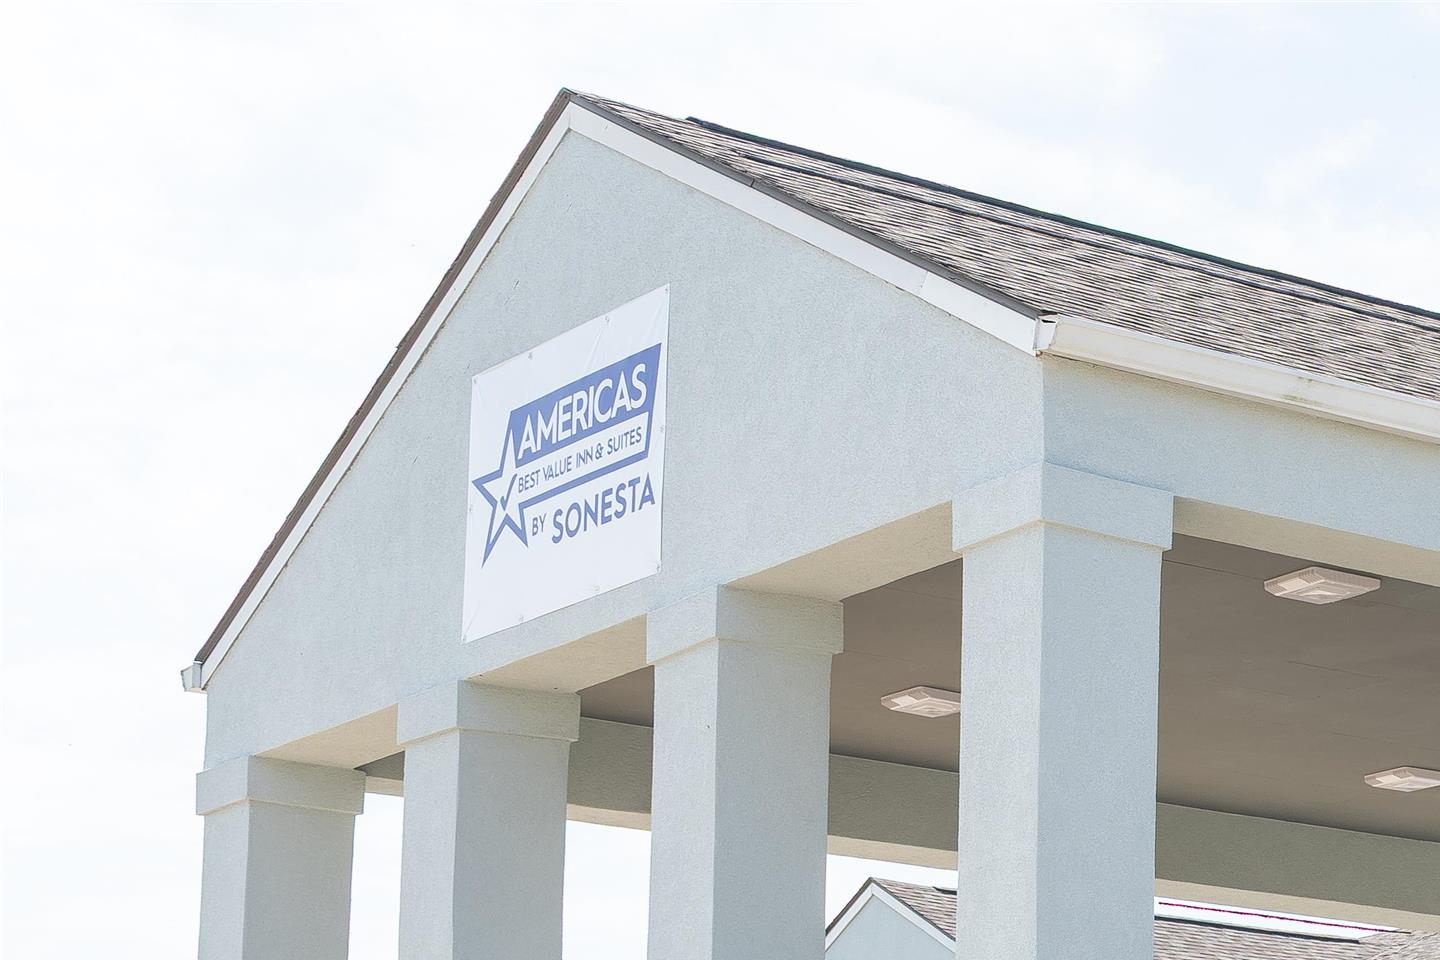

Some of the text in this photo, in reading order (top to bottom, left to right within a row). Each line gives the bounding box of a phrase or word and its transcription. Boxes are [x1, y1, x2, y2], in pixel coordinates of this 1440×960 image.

[517, 363, 647, 460] AMERICAS
[518, 426, 642, 493] BEST VALUE INN & SUITES
[532, 472, 655, 544] BY SONESTA
